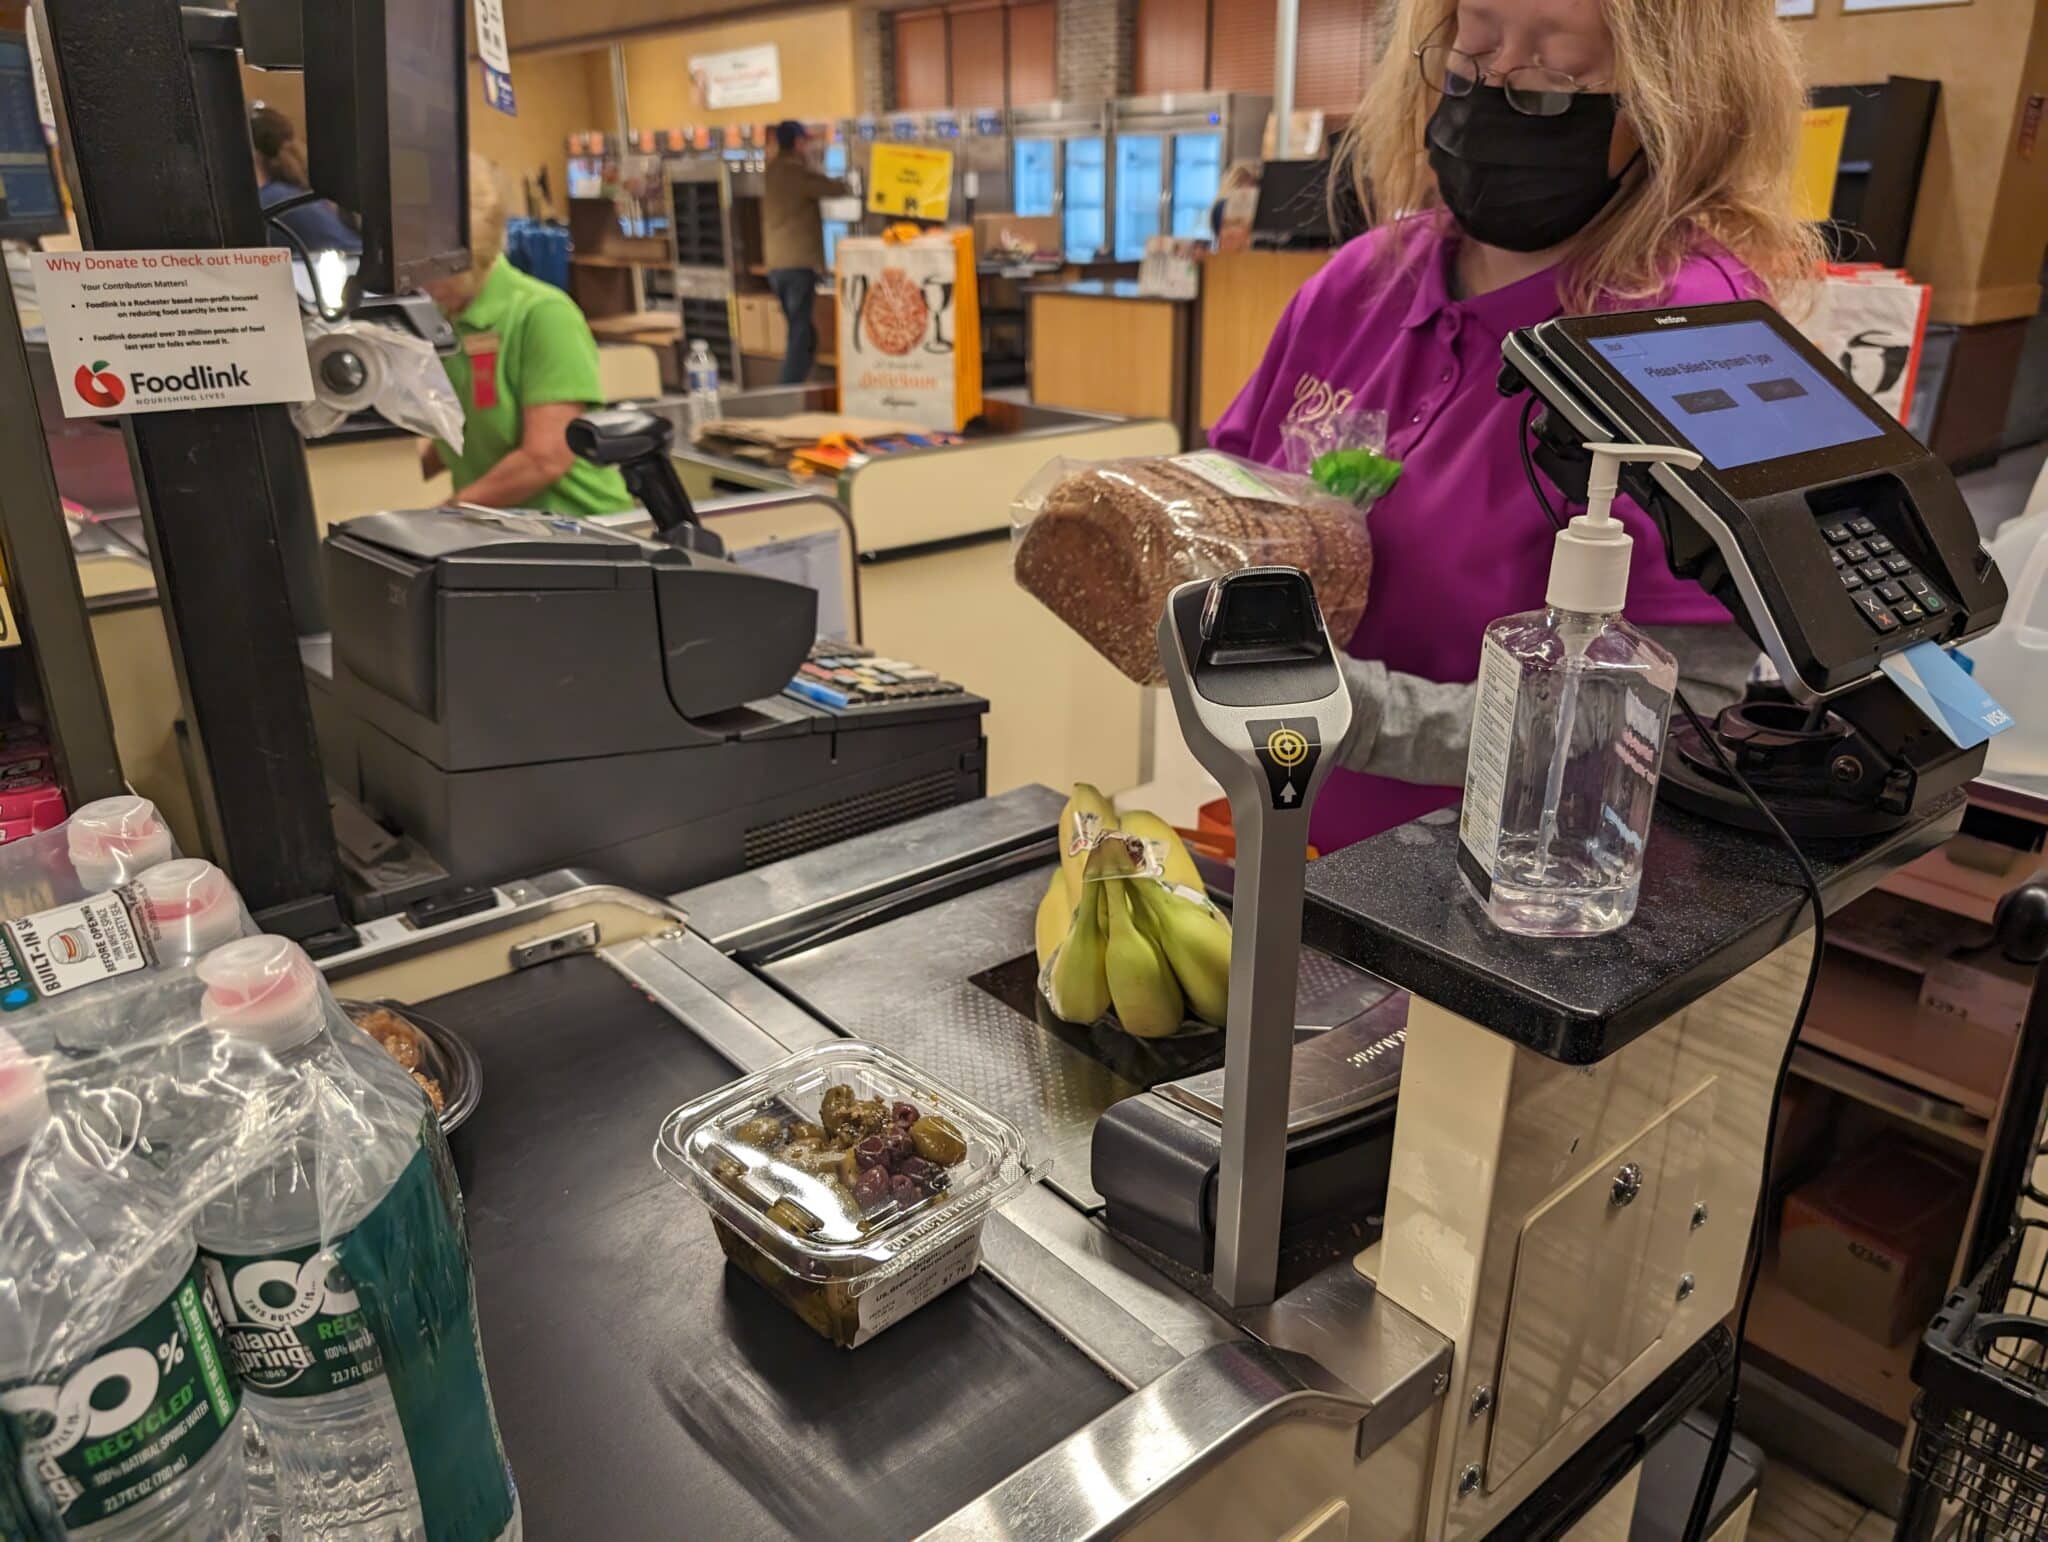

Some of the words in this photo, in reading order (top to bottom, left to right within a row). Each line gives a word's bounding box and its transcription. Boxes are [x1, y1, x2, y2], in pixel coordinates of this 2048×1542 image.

[46, 257, 80, 272] Why
[85, 257, 138, 270] Donate
[142, 256, 158, 269] to
[161, 254, 203, 268] Check
[207, 254, 231, 267] out
[234, 251, 290, 268] Hunger?
[81, 283, 101, 291] Your
[103, 281, 153, 291] Contribution
[154, 279, 188, 290] Matters!
[86, 300, 119, 309] Foodlink
[120, 300, 126, 308] is
[134, 297, 170, 307] Rochester
[172, 297, 193, 305] based
[194, 294, 230, 304] non-profit
[231, 294, 259, 302] focused
[117, 311, 128, 319] on
[129, 309, 162, 318] reducing
[162, 308, 179, 316] food
[180, 306, 208, 316] scarcity
[217, 305, 230, 313] the
[230, 305, 248, 313] area.
[93, 333, 126, 341] Foodlink
[127, 330, 158, 340] donated
[188, 328, 212, 336] million
[214, 327, 239, 335] pounds
[249, 325, 265, 333] food
[125, 343, 139, 351] last
[140, 343, 156, 351] year
[157, 341, 166, 349] to
[167, 340, 184, 348] folks
[186, 339, 202, 347] who
[203, 338, 220, 346] need
[1643, 364, 1682, 378] Please
[1677, 359, 1713, 373] Select
[1705, 354, 1751, 371] Payment
[129, 363, 252, 395] Foodlink
[136, 394, 197, 406] NOURISHING
[200, 392, 226, 402] LIVES
[80, 905, 104, 941] OPENING
[96, 907, 113, 928] SPACE
[104, 925, 122, 947] WHITE
[112, 916, 132, 941] SAFETY
[95, 940, 118, 974] BEFORE
[123, 939, 135, 954] RED
[21, 931, 62, 993] BUILT-IN
[270, 1303, 311, 1323] BOTTLE
[317, 1311, 369, 1340] REC
[230, 1323, 301, 1352] oland
[233, 1345, 309, 1374] pring
[330, 1367, 351, 1385] 23.7
[350, 1365, 362, 1379] FL
[120, 1441, 161, 1474] NATURAL
[184, 1399, 210, 1429] WATER
